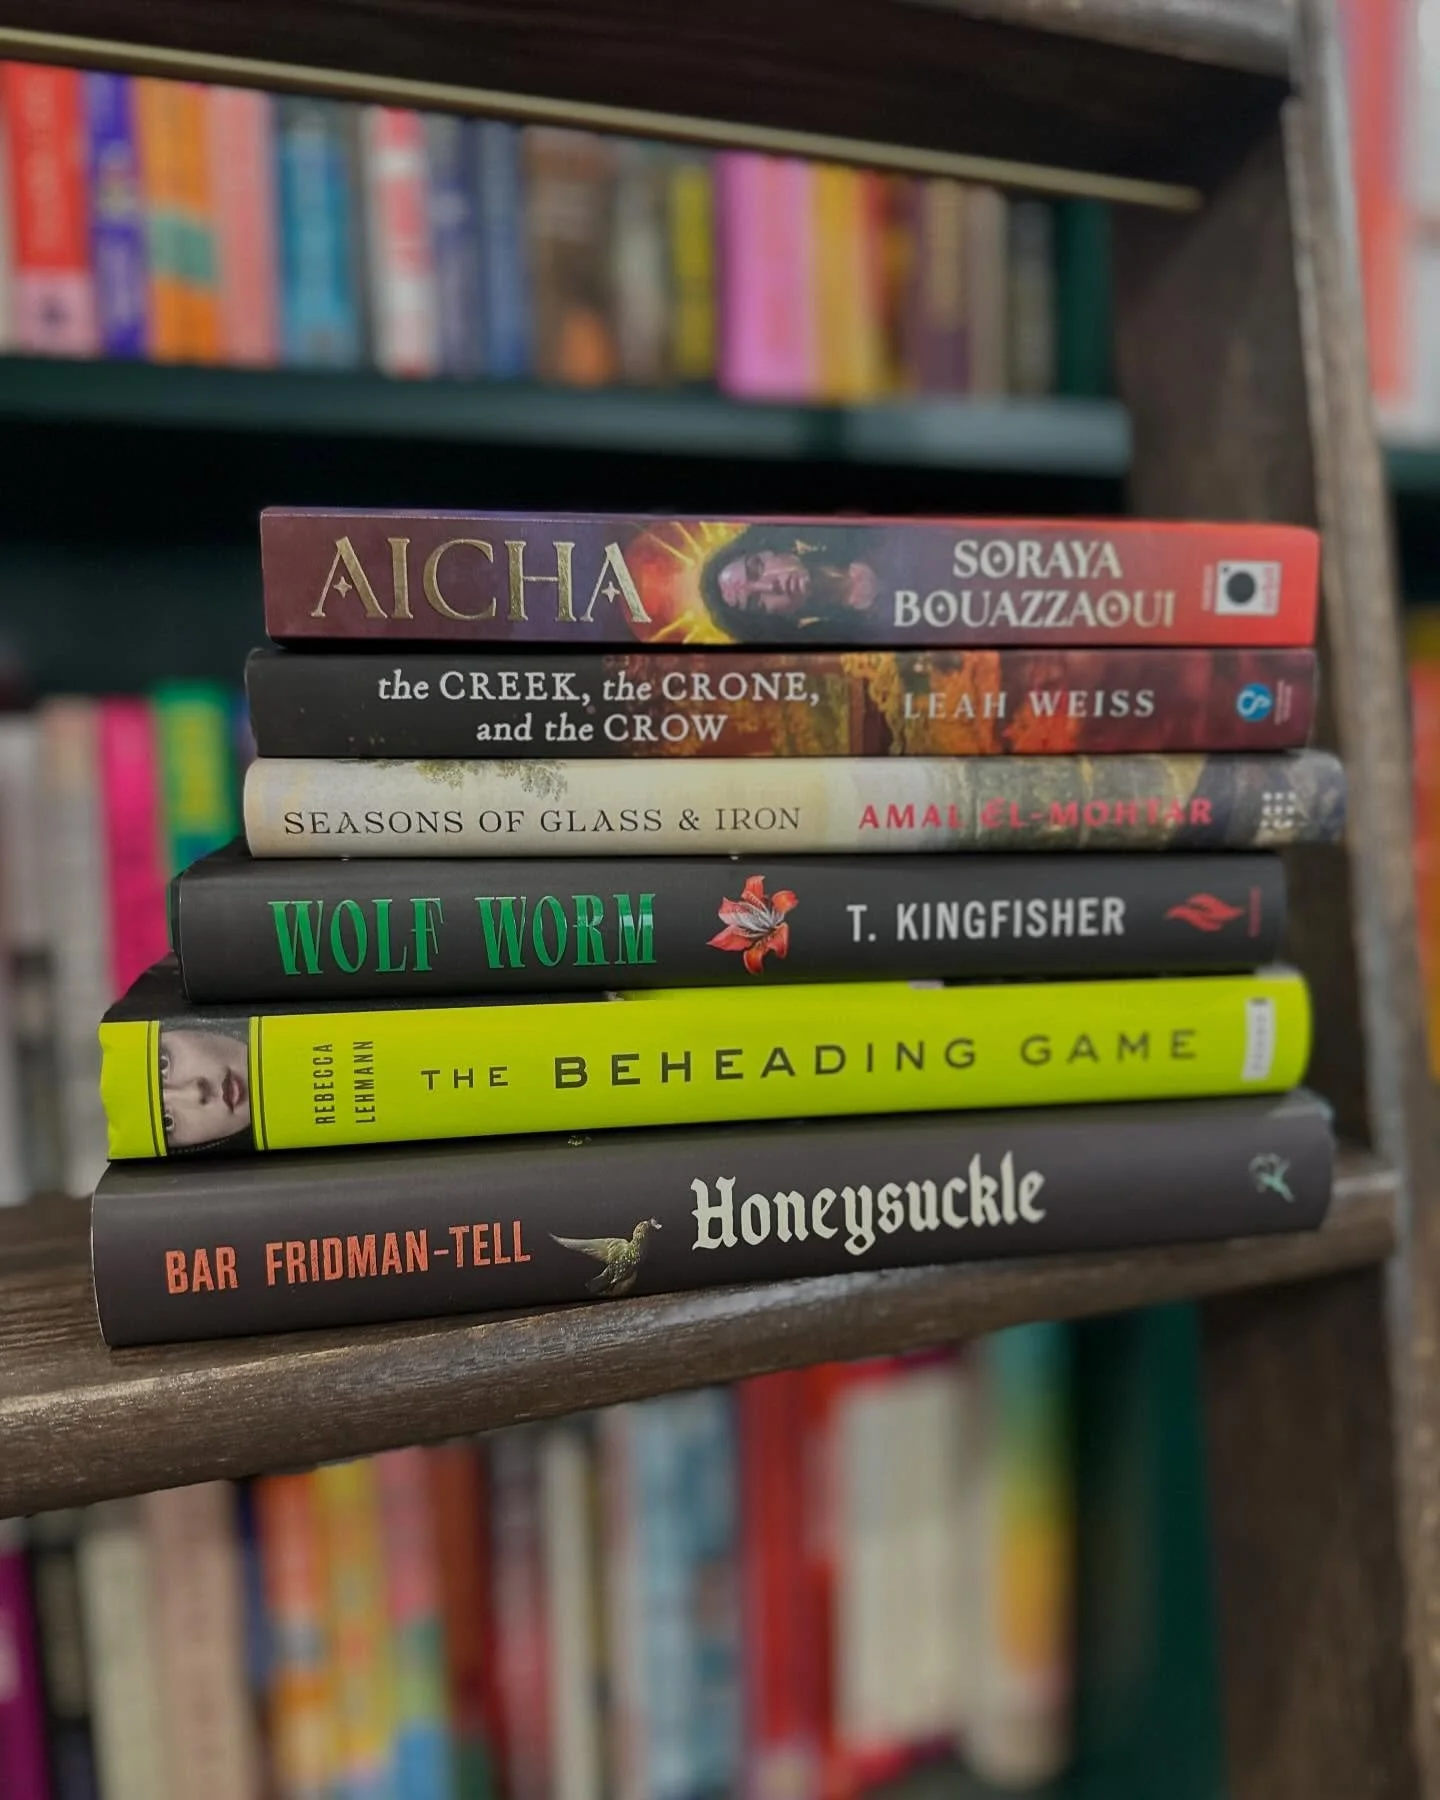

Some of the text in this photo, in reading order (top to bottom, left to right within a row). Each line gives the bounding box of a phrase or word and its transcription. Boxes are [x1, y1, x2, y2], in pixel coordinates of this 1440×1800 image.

[311, 535, 652, 624] AICHA
[953, 540, 1122, 579] SORAYA
[893, 590, 1176, 628] BOUAZZAOUI
[378, 668, 819, 707] the CREEK, the CRONE,
[904, 690, 1156, 720] LEAH WEISS
[476, 713, 728, 742] and the CROW
[284, 807, 800, 835] SEASONS OF GLASS & IRON
[859, 798, 1214, 831] AMAL EL-MOHTAR
[269, 893, 657, 976] WOLF WORM
[847, 896, 1125, 942] T. KINGFISHER
[354, 1039, 375, 1123] LEHMANN
[421, 1029, 1197, 1090] THE BEHEADING GAME
[315, 1043, 334, 1125] REBECCA
[690, 1150, 1047, 1257] Honeysuckle
[165, 1220, 531, 1295] BAR FRIDMAN-TELL
